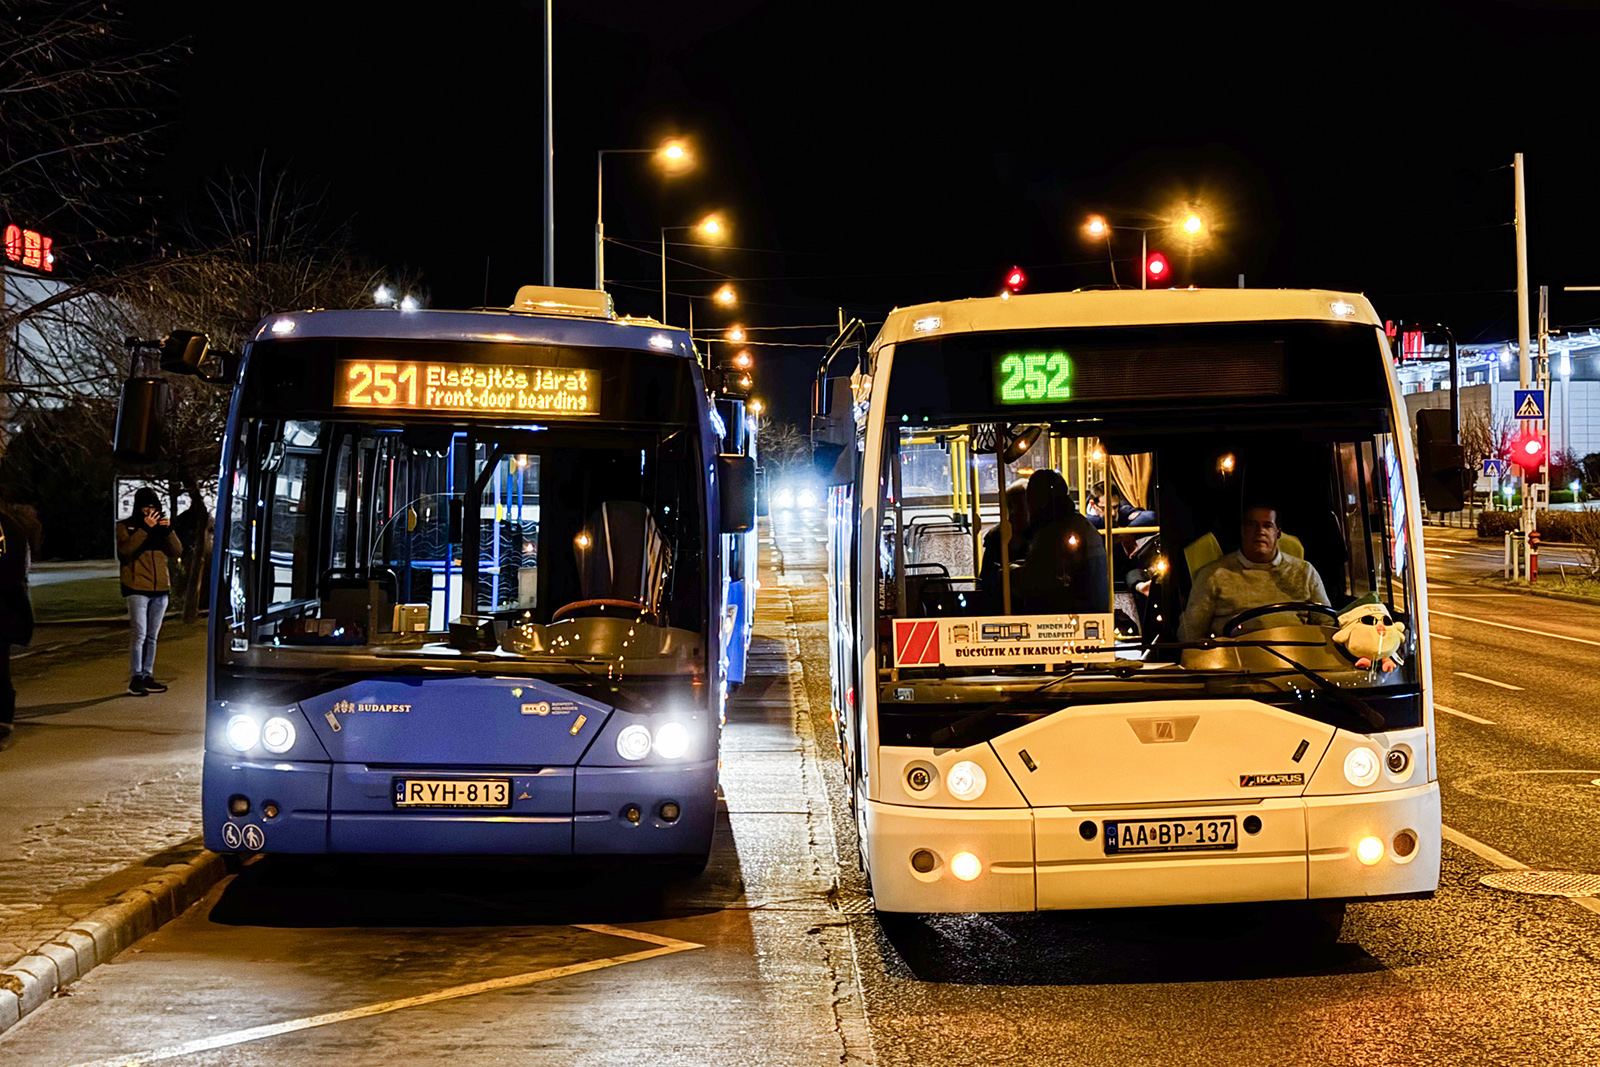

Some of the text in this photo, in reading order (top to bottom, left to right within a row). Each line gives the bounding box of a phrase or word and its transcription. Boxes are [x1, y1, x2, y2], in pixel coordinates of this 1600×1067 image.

[348, 364, 417, 404] 251
[426, 366, 588, 391] Elsőajtós járat
[1001, 352, 1070, 400] 252
[426, 387, 588, 411] Front-door boarding
[955, 646, 1006, 657] BÚCSÚZIK
[1008, 647, 1021, 656] AZ
[1023, 646, 1061, 656] IKARUS
[358, 704, 412, 713] BUDAPEST
[1256, 774, 1303, 784] IKARUS
[396, 793, 404, 801] H
[410, 783, 506, 802] RYH-813
[1108, 837, 1116, 846] H
[1122, 821, 1231, 846] AA BP-137
